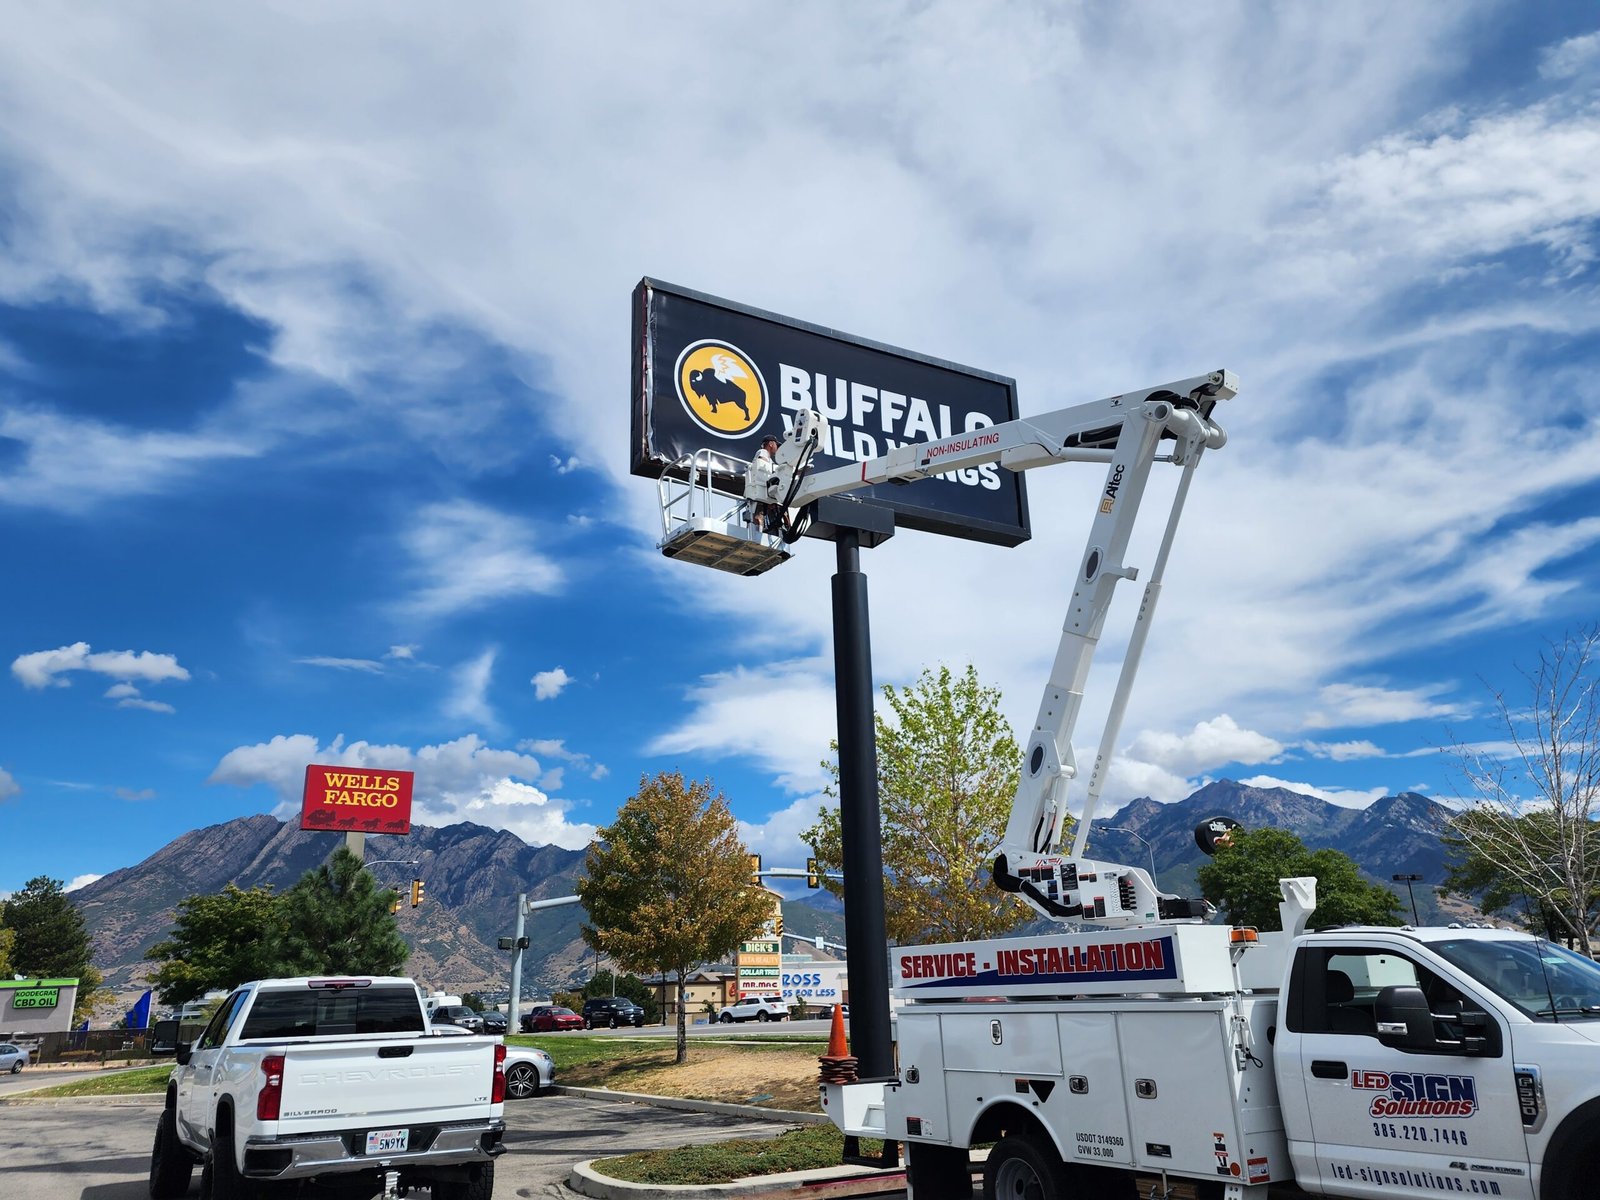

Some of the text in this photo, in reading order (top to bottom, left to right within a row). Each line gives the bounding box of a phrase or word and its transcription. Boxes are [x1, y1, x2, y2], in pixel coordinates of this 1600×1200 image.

[926, 432, 1000, 459] NON-INSULATING
[1105, 463, 1125, 499] Altec
[324, 772, 400, 791] WELLS
[323, 789, 398, 808] FARGO
[745, 943, 773, 953] DICK'S
[901, 952, 977, 979] SERVICE
[997, 940, 1165, 976] INSTALLATION
[782, 973, 821, 986] ROSS
[795, 989, 813, 997] FOR
[815, 988, 836, 997] LESS
[15, 998, 55, 1007] CBD OIL
[298, 1064, 481, 1086] CHEVROLET
[1352, 1071, 1476, 1105] LED SIGN
[283, 1108, 338, 1117] SILVERADO
[1371, 1098, 1474, 1116] Solutions
[1076, 1132, 1124, 1146] USDOT 3149360
[1373, 1122, 1468, 1146] 385.220.7446
[379, 1137, 406, 1150] 5N9YK
[1077, 1145, 1114, 1158] GVW 33,000
[1331, 1163, 1502, 1196] led-signsolutions.com
